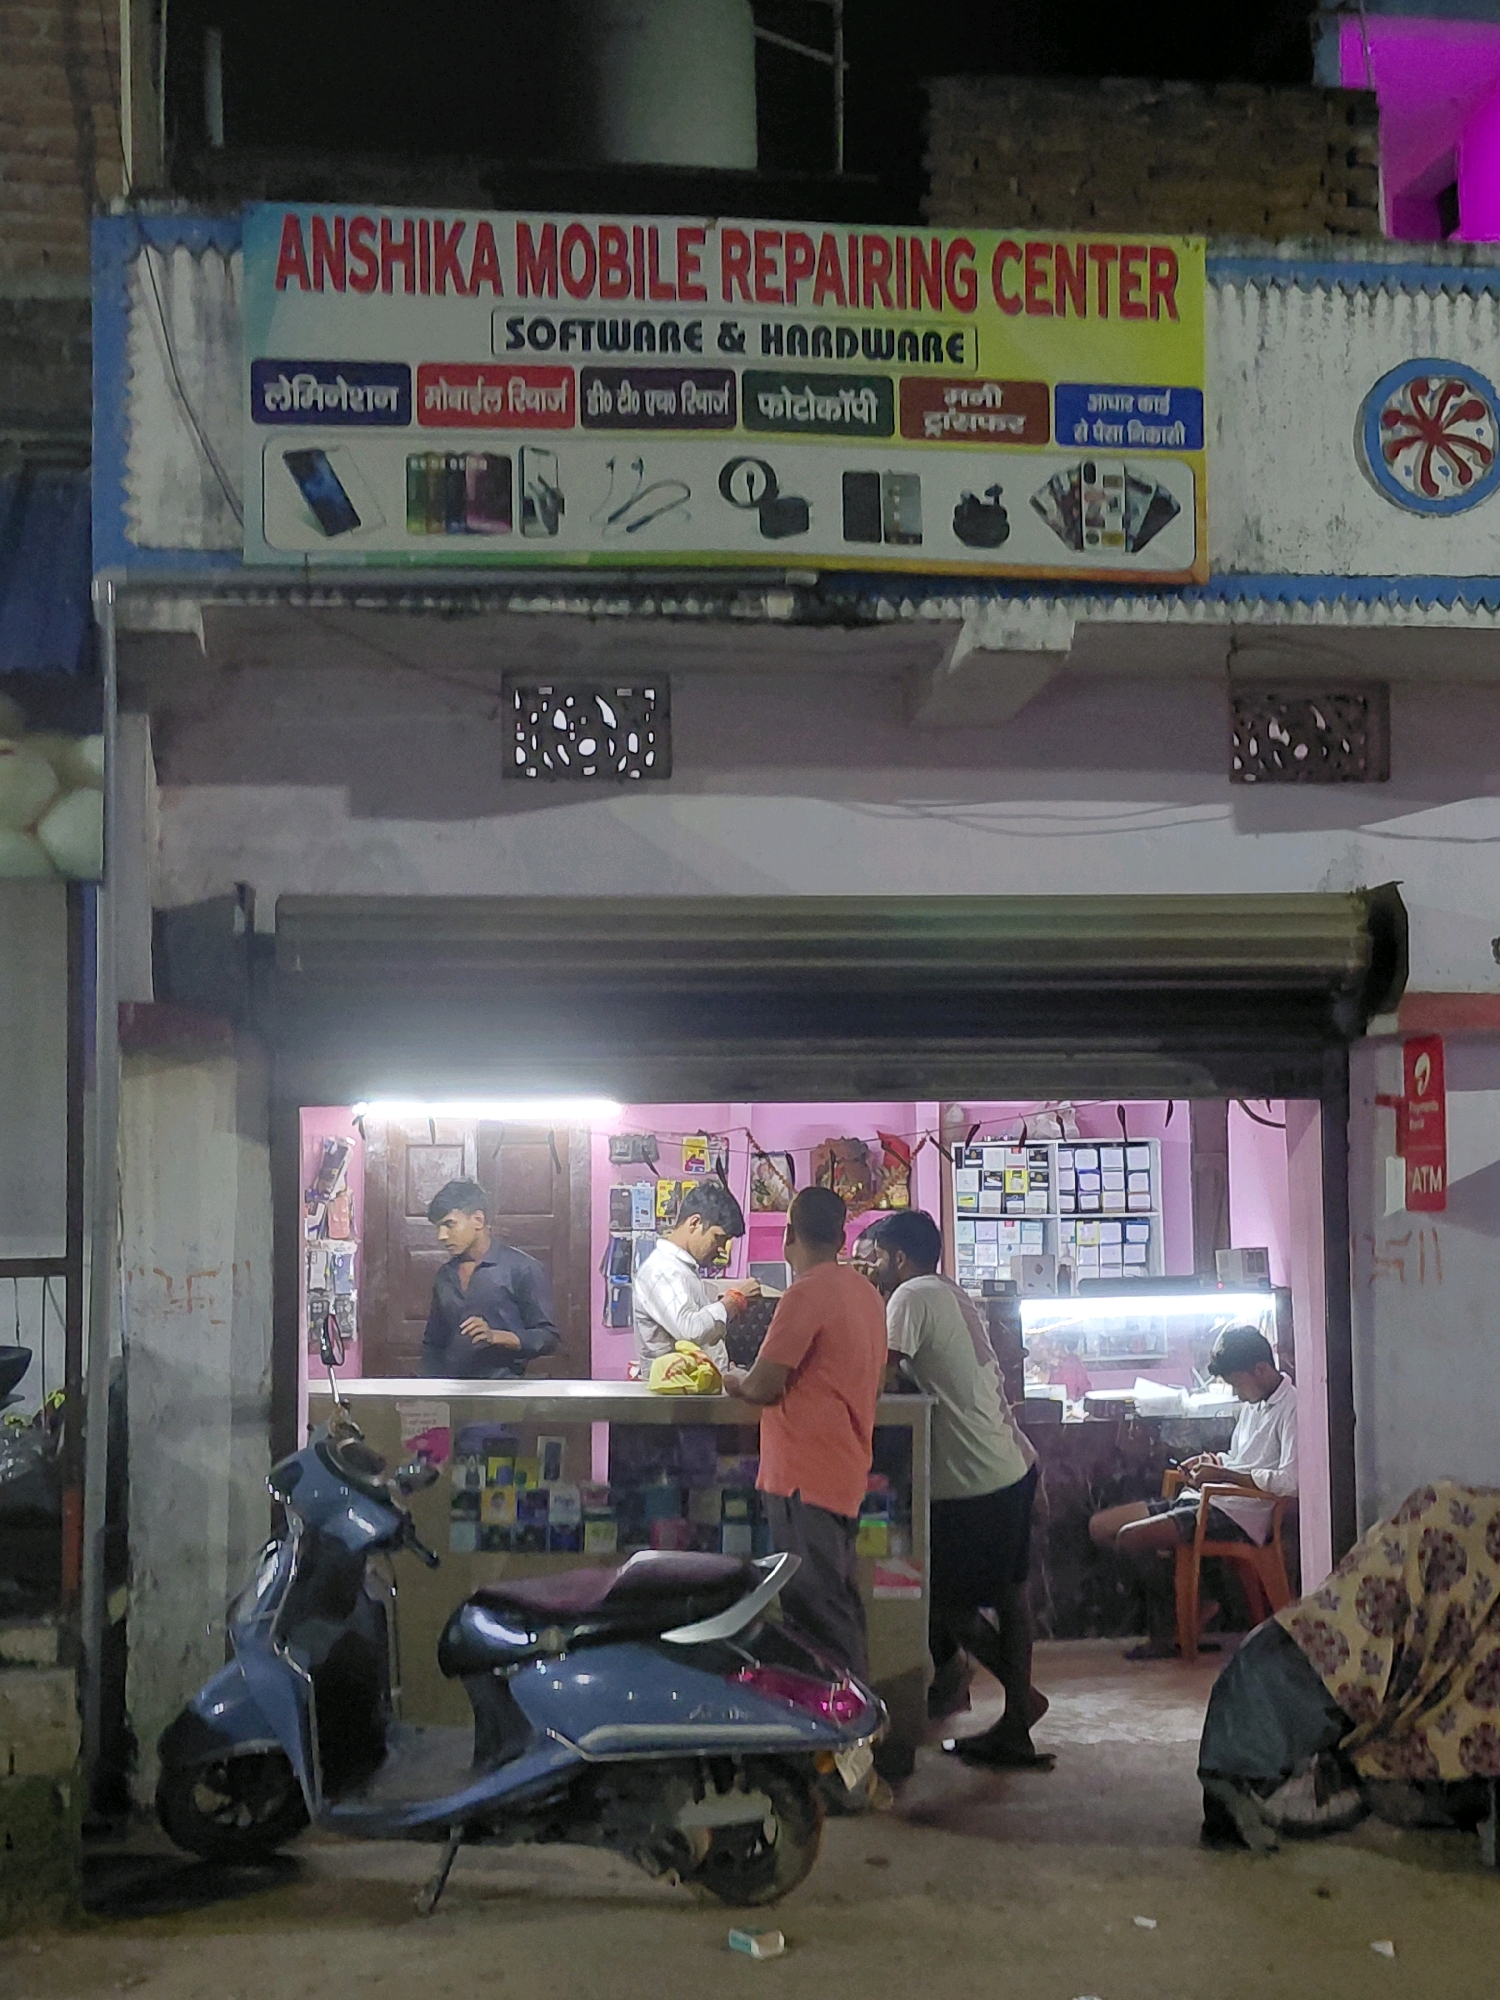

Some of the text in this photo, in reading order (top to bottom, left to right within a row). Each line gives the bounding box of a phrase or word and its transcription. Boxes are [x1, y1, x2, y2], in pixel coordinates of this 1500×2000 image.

[275, 213, 1181, 323] ANSHIKA MOBILE REPAIRING CENTER
[505, 316, 966, 364] SOFTWARE & HARDWARE
[757, 384, 879, 425] फोटोकॉपी
[1411, 1165, 1443, 1194] ATM
